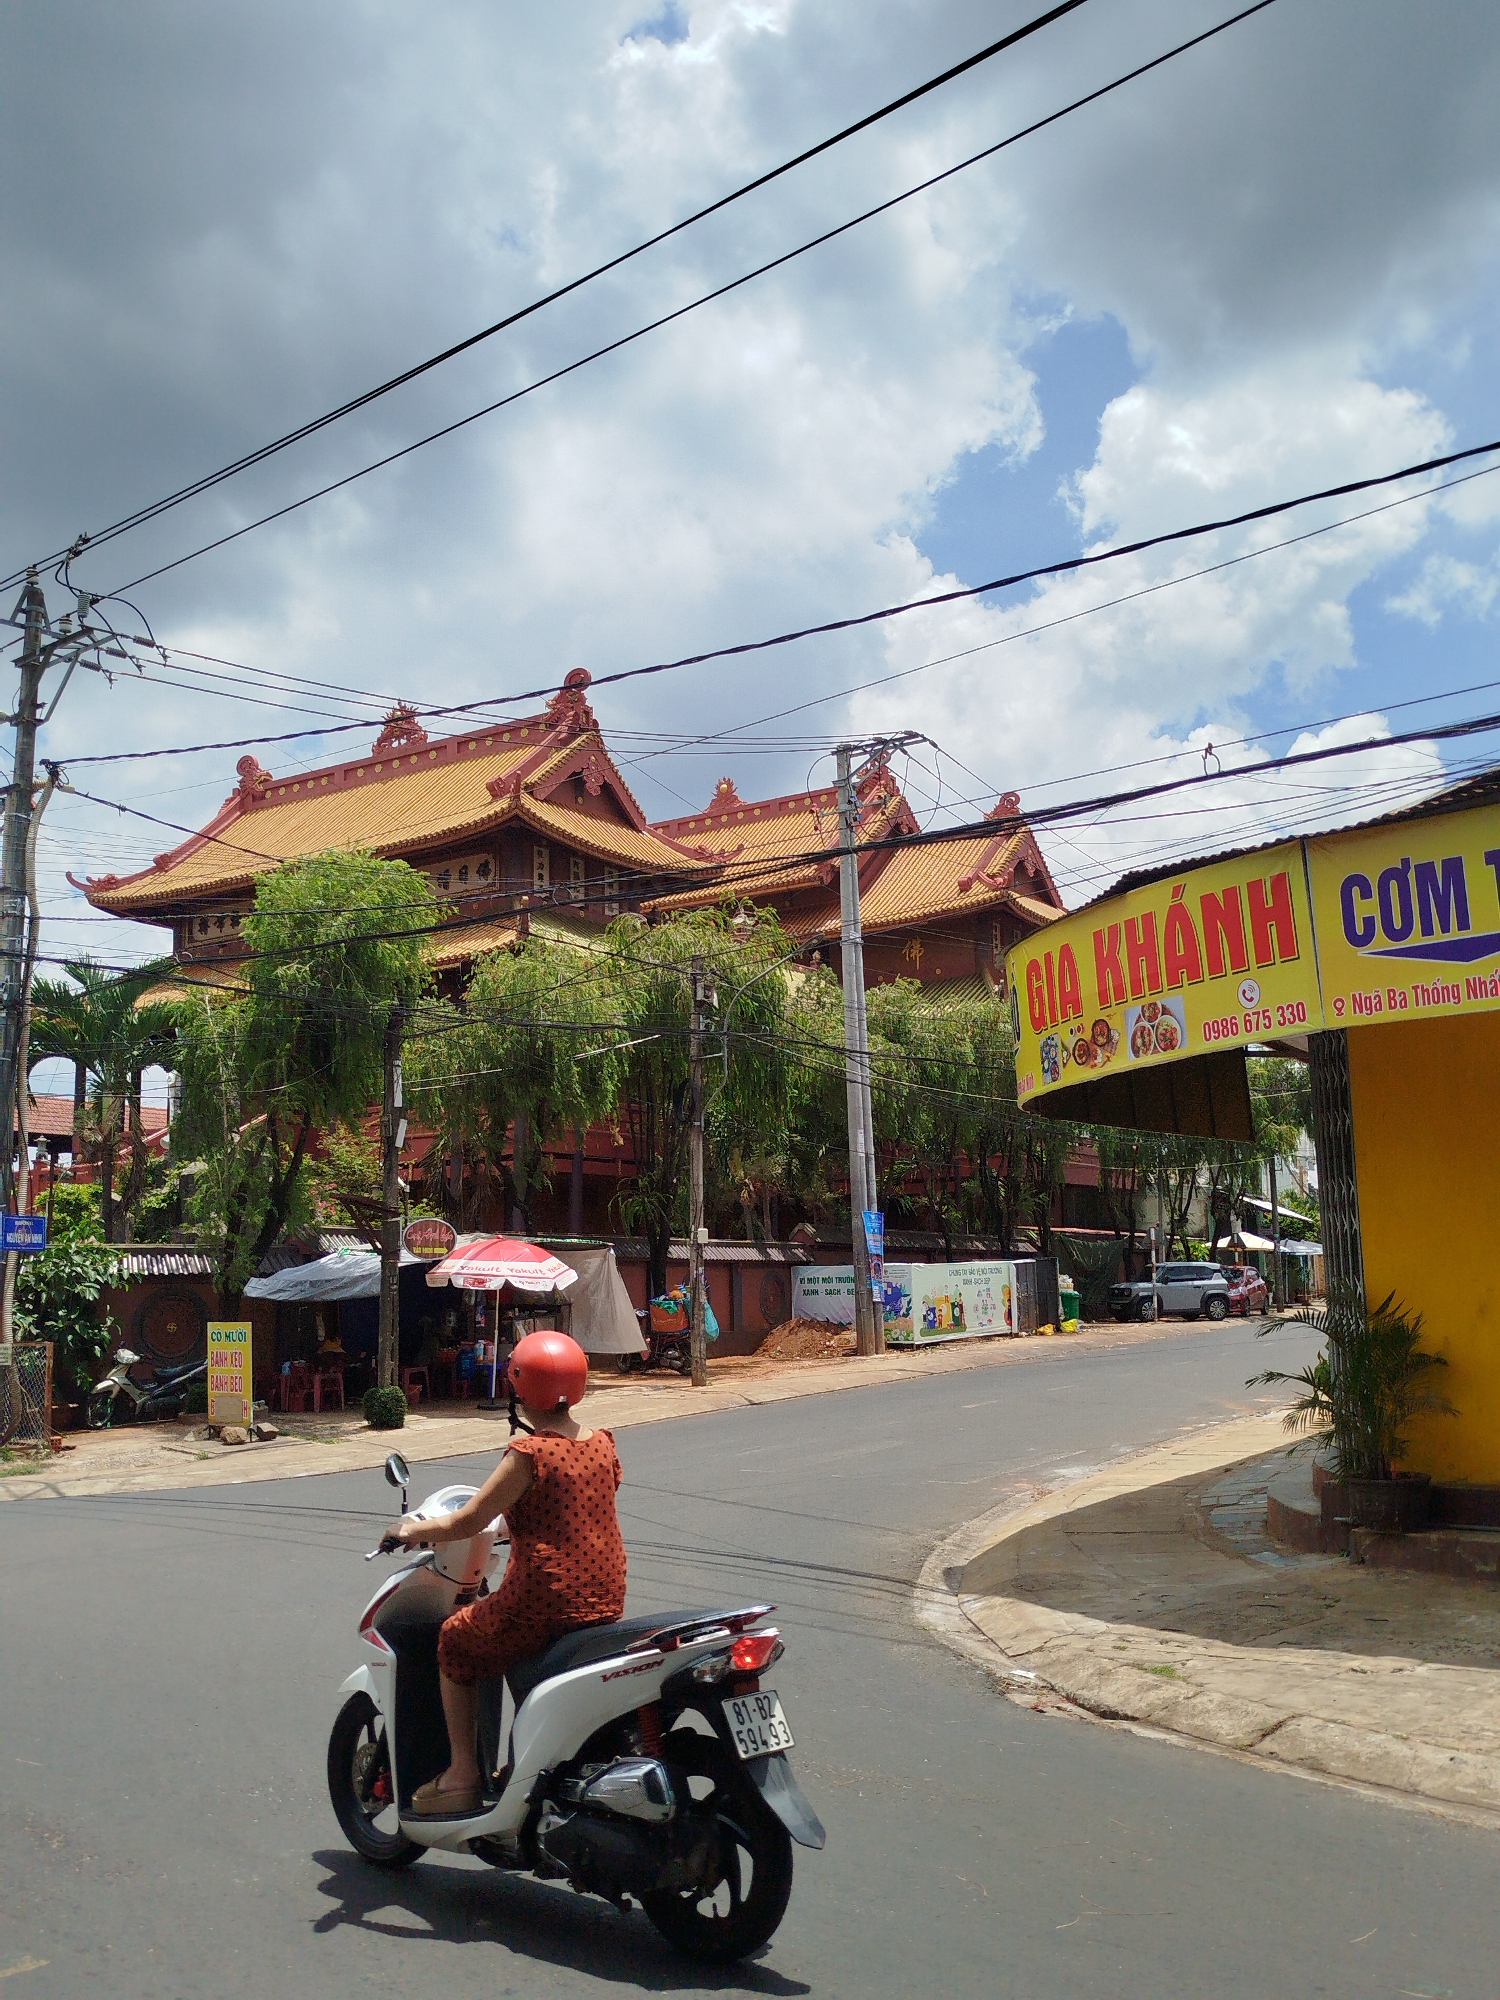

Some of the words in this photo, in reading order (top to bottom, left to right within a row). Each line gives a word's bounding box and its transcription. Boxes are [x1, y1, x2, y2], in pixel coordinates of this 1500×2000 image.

[1340, 855, 1471, 948] CƠM
[1025, 942, 1083, 1035] GIA
[1092, 871, 1300, 1011] KHÁNH
[1351, 989, 1383, 1016] Ngã
[1387, 988, 1408, 1011] Ba
[1411, 977, 1462, 1006] Thống
[1465, 968, 1500, 1001] Nhấ
[1202, 1015, 1240, 1042] 0986
[1243, 1007, 1272, 1034] 675
[1276, 1000, 1307, 1027] 330
[460, 1265, 501, 1273] Yakult
[506, 1267, 546, 1275] Yakult
[834, 1274, 855, 1284] TRƯỜN
[802, 1288, 819, 1296] XANH
[824, 1288, 841, 1297] SẠCH
[210, 1328, 223, 1342] CÔ
[224, 1327, 247, 1342] MƯỜI
[210, 1347, 228, 1368] BÁNH
[210, 1371, 228, 1393] BÁNH
[599, 1658, 666, 1683] VISION
[736, 1720, 790, 1754] 594.93
